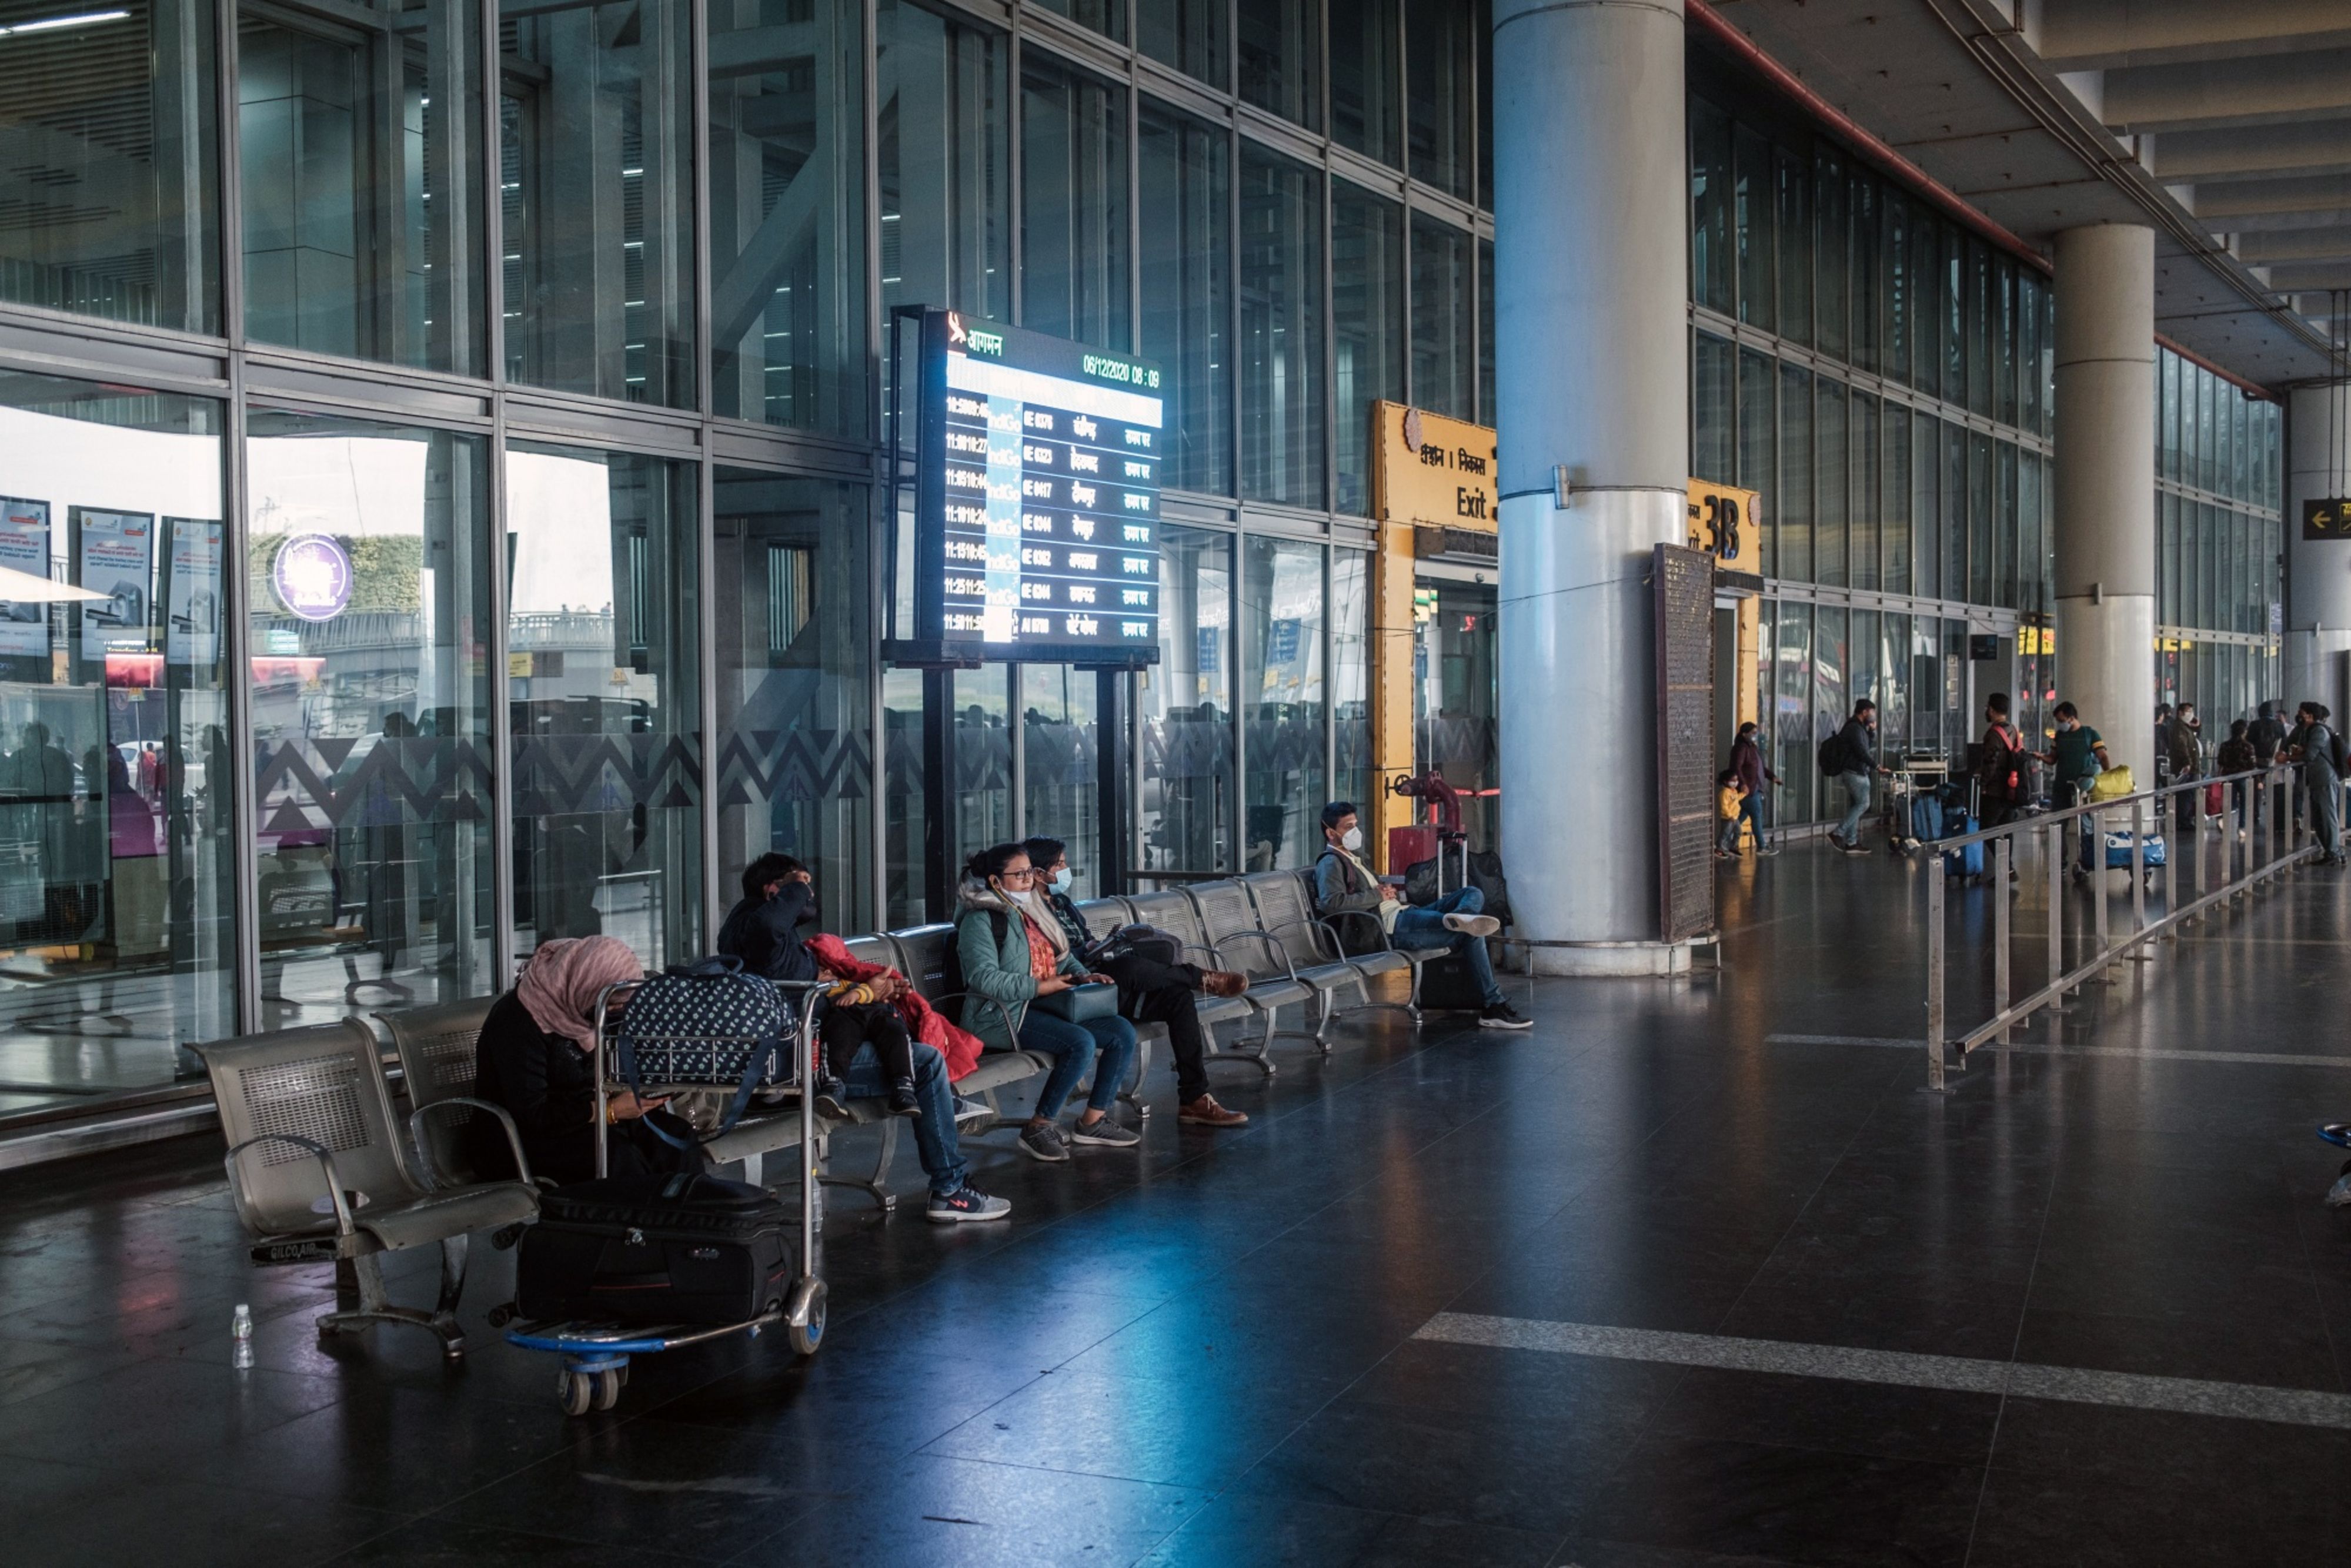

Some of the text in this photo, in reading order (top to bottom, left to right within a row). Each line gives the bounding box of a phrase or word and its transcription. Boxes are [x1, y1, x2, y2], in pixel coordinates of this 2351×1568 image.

[967, 330, 1003, 356] आगमन
[1084, 356, 1130, 383] 06/12/2020
[1457, 486, 1487, 520] Exit
[1704, 494, 1740, 560] 3B
